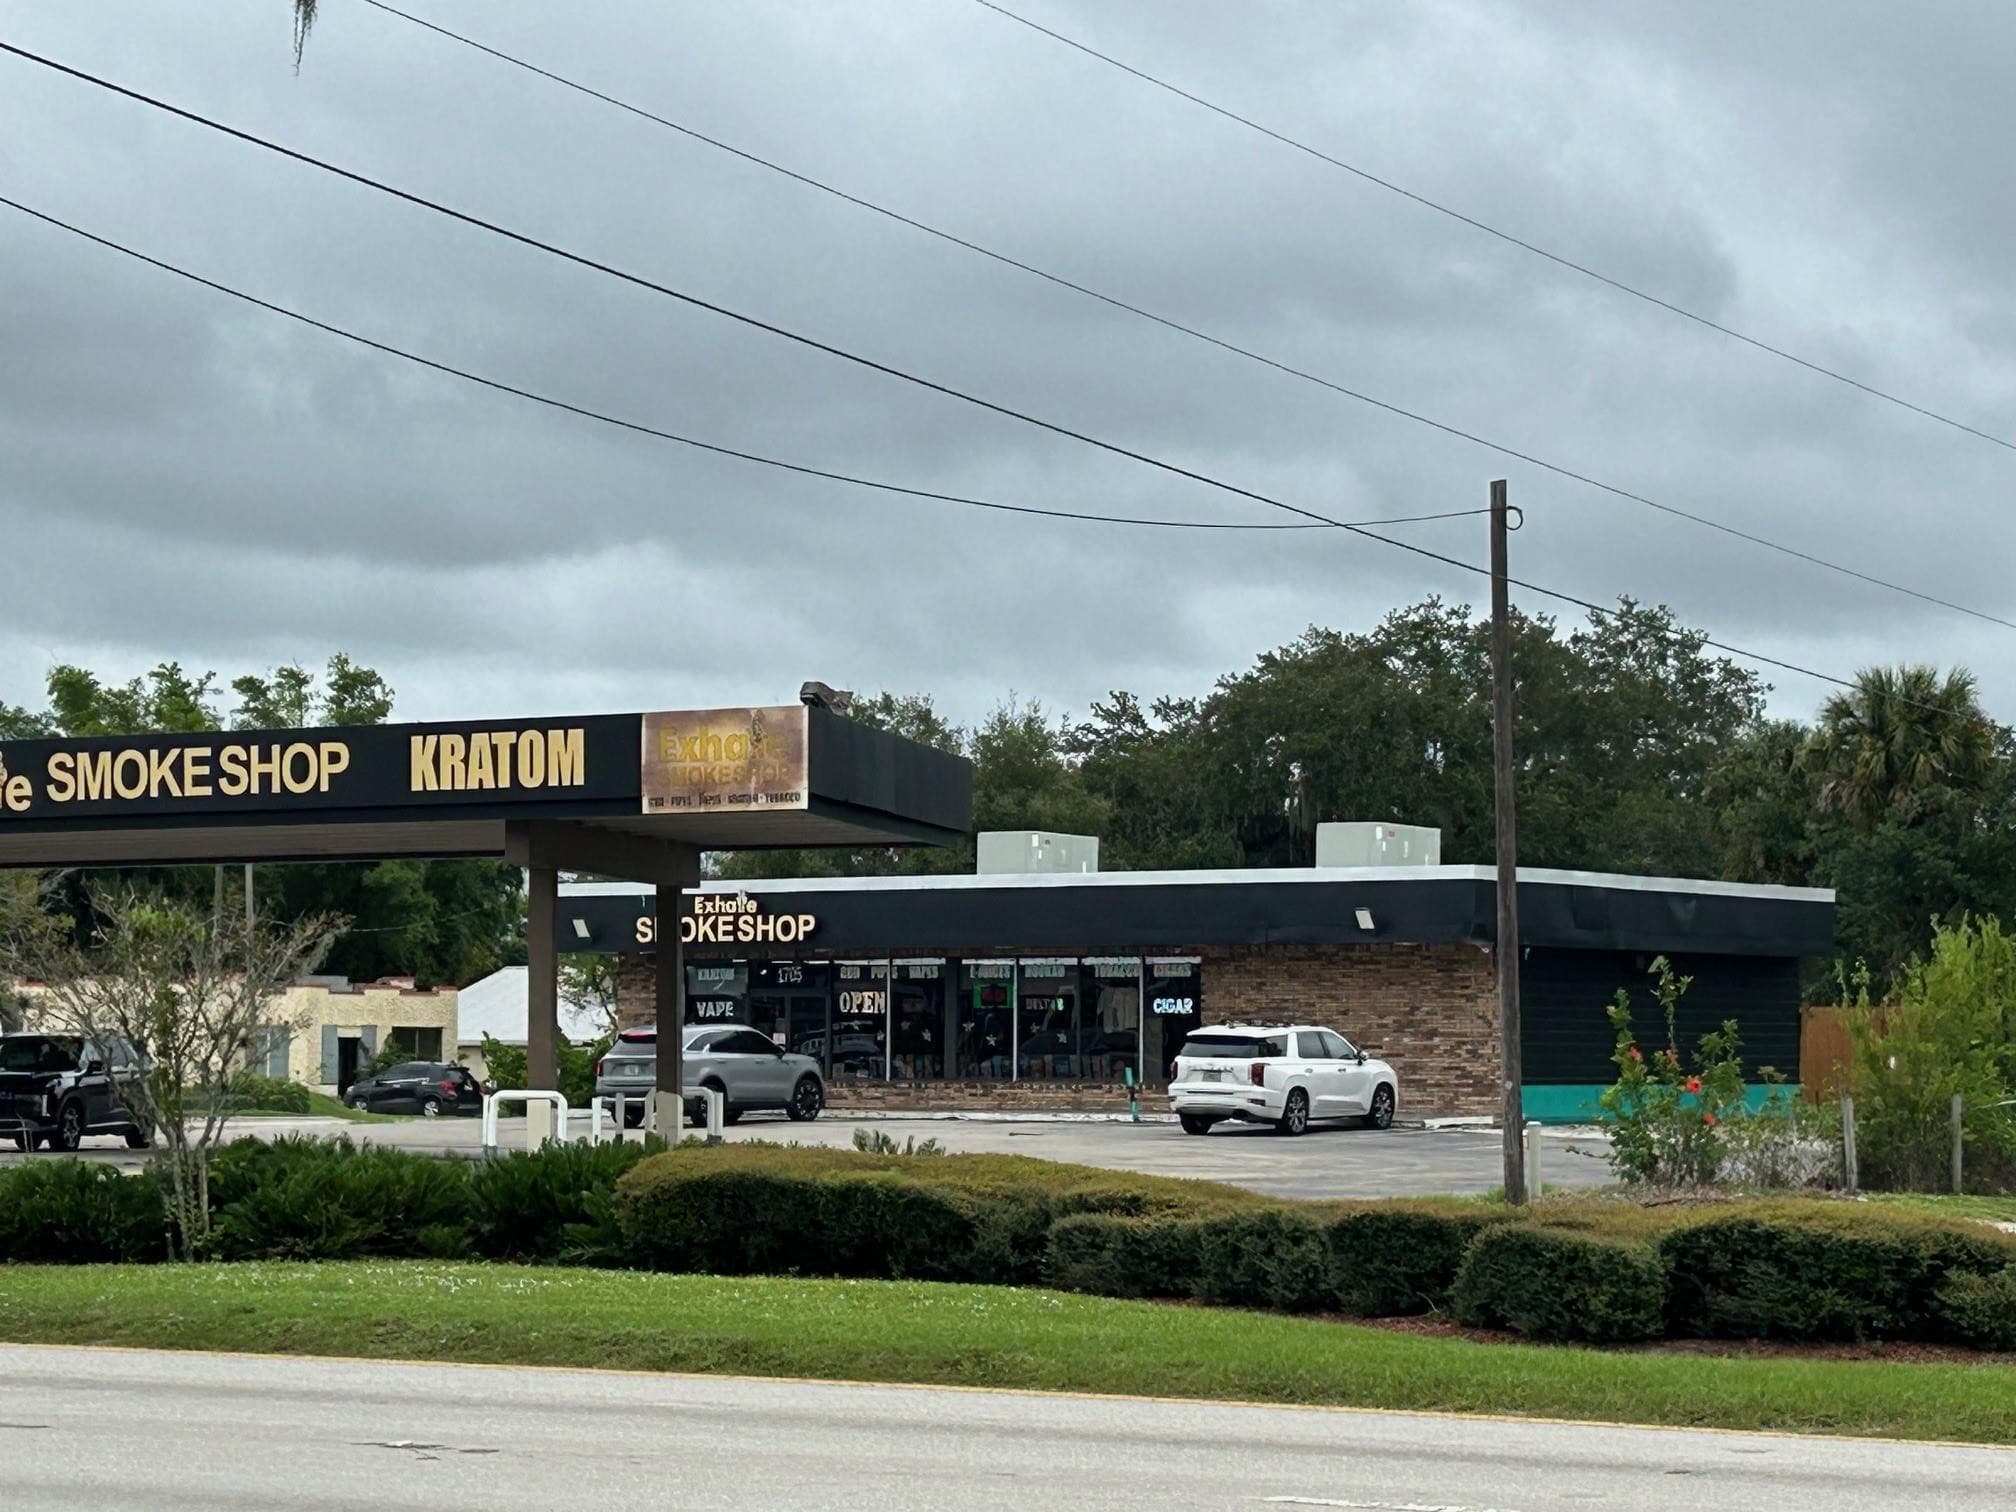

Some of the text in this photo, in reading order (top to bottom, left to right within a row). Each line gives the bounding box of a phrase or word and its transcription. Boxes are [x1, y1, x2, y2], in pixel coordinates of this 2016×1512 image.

[410, 728, 585, 792] KRATOM
[697, 1001, 735, 1018] VAPE
[839, 991, 887, 1014] OPEN
[1153, 998, 1194, 1015] CIGAR
